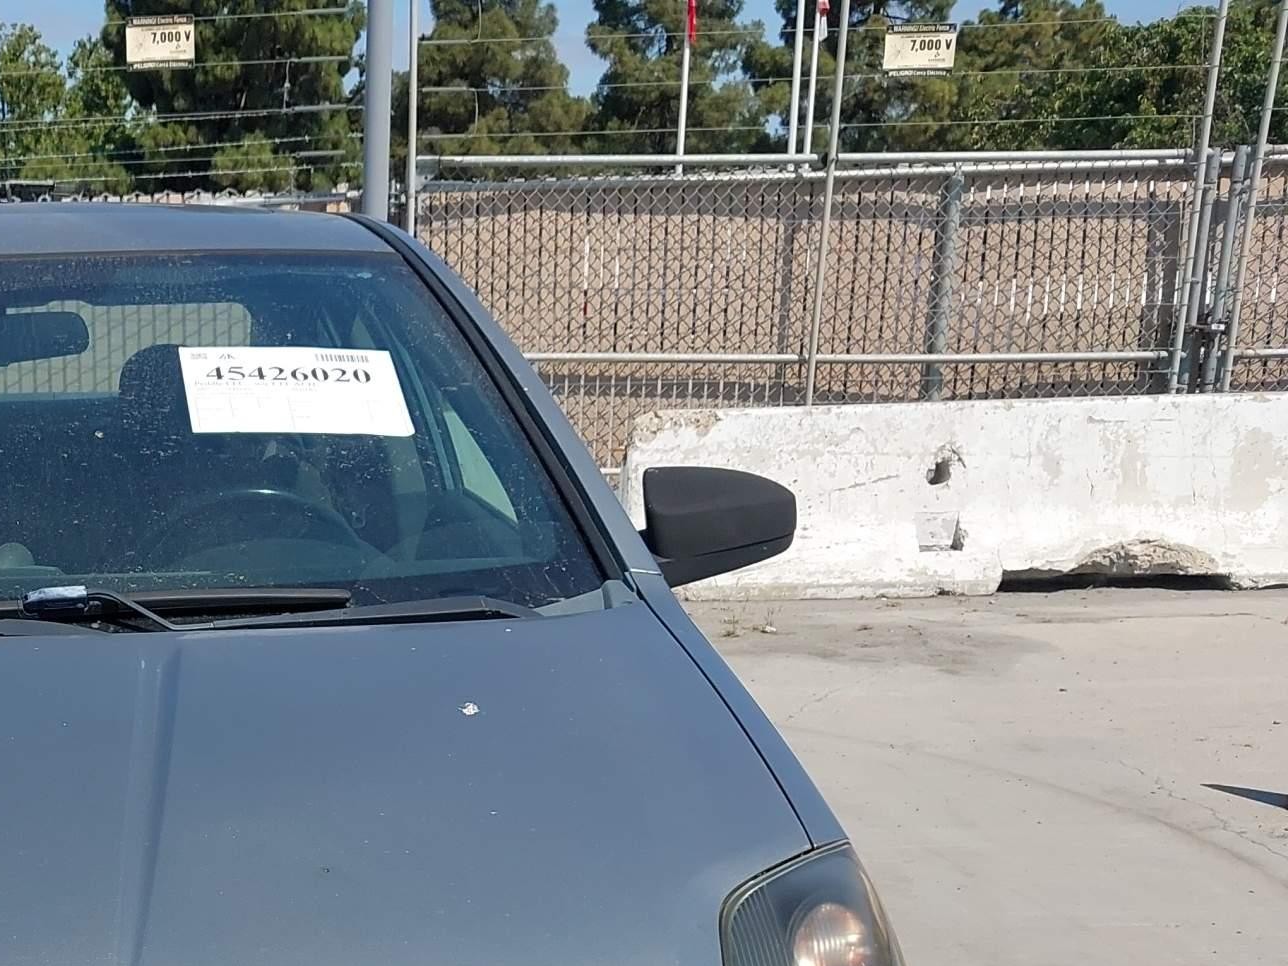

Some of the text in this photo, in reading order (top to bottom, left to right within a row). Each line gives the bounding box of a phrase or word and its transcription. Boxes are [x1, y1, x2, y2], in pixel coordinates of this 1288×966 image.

[151, 30, 191, 45] 7,000 V
[910, 39, 953, 52] 7,000 V
[206, 365, 372, 384] 45426020
